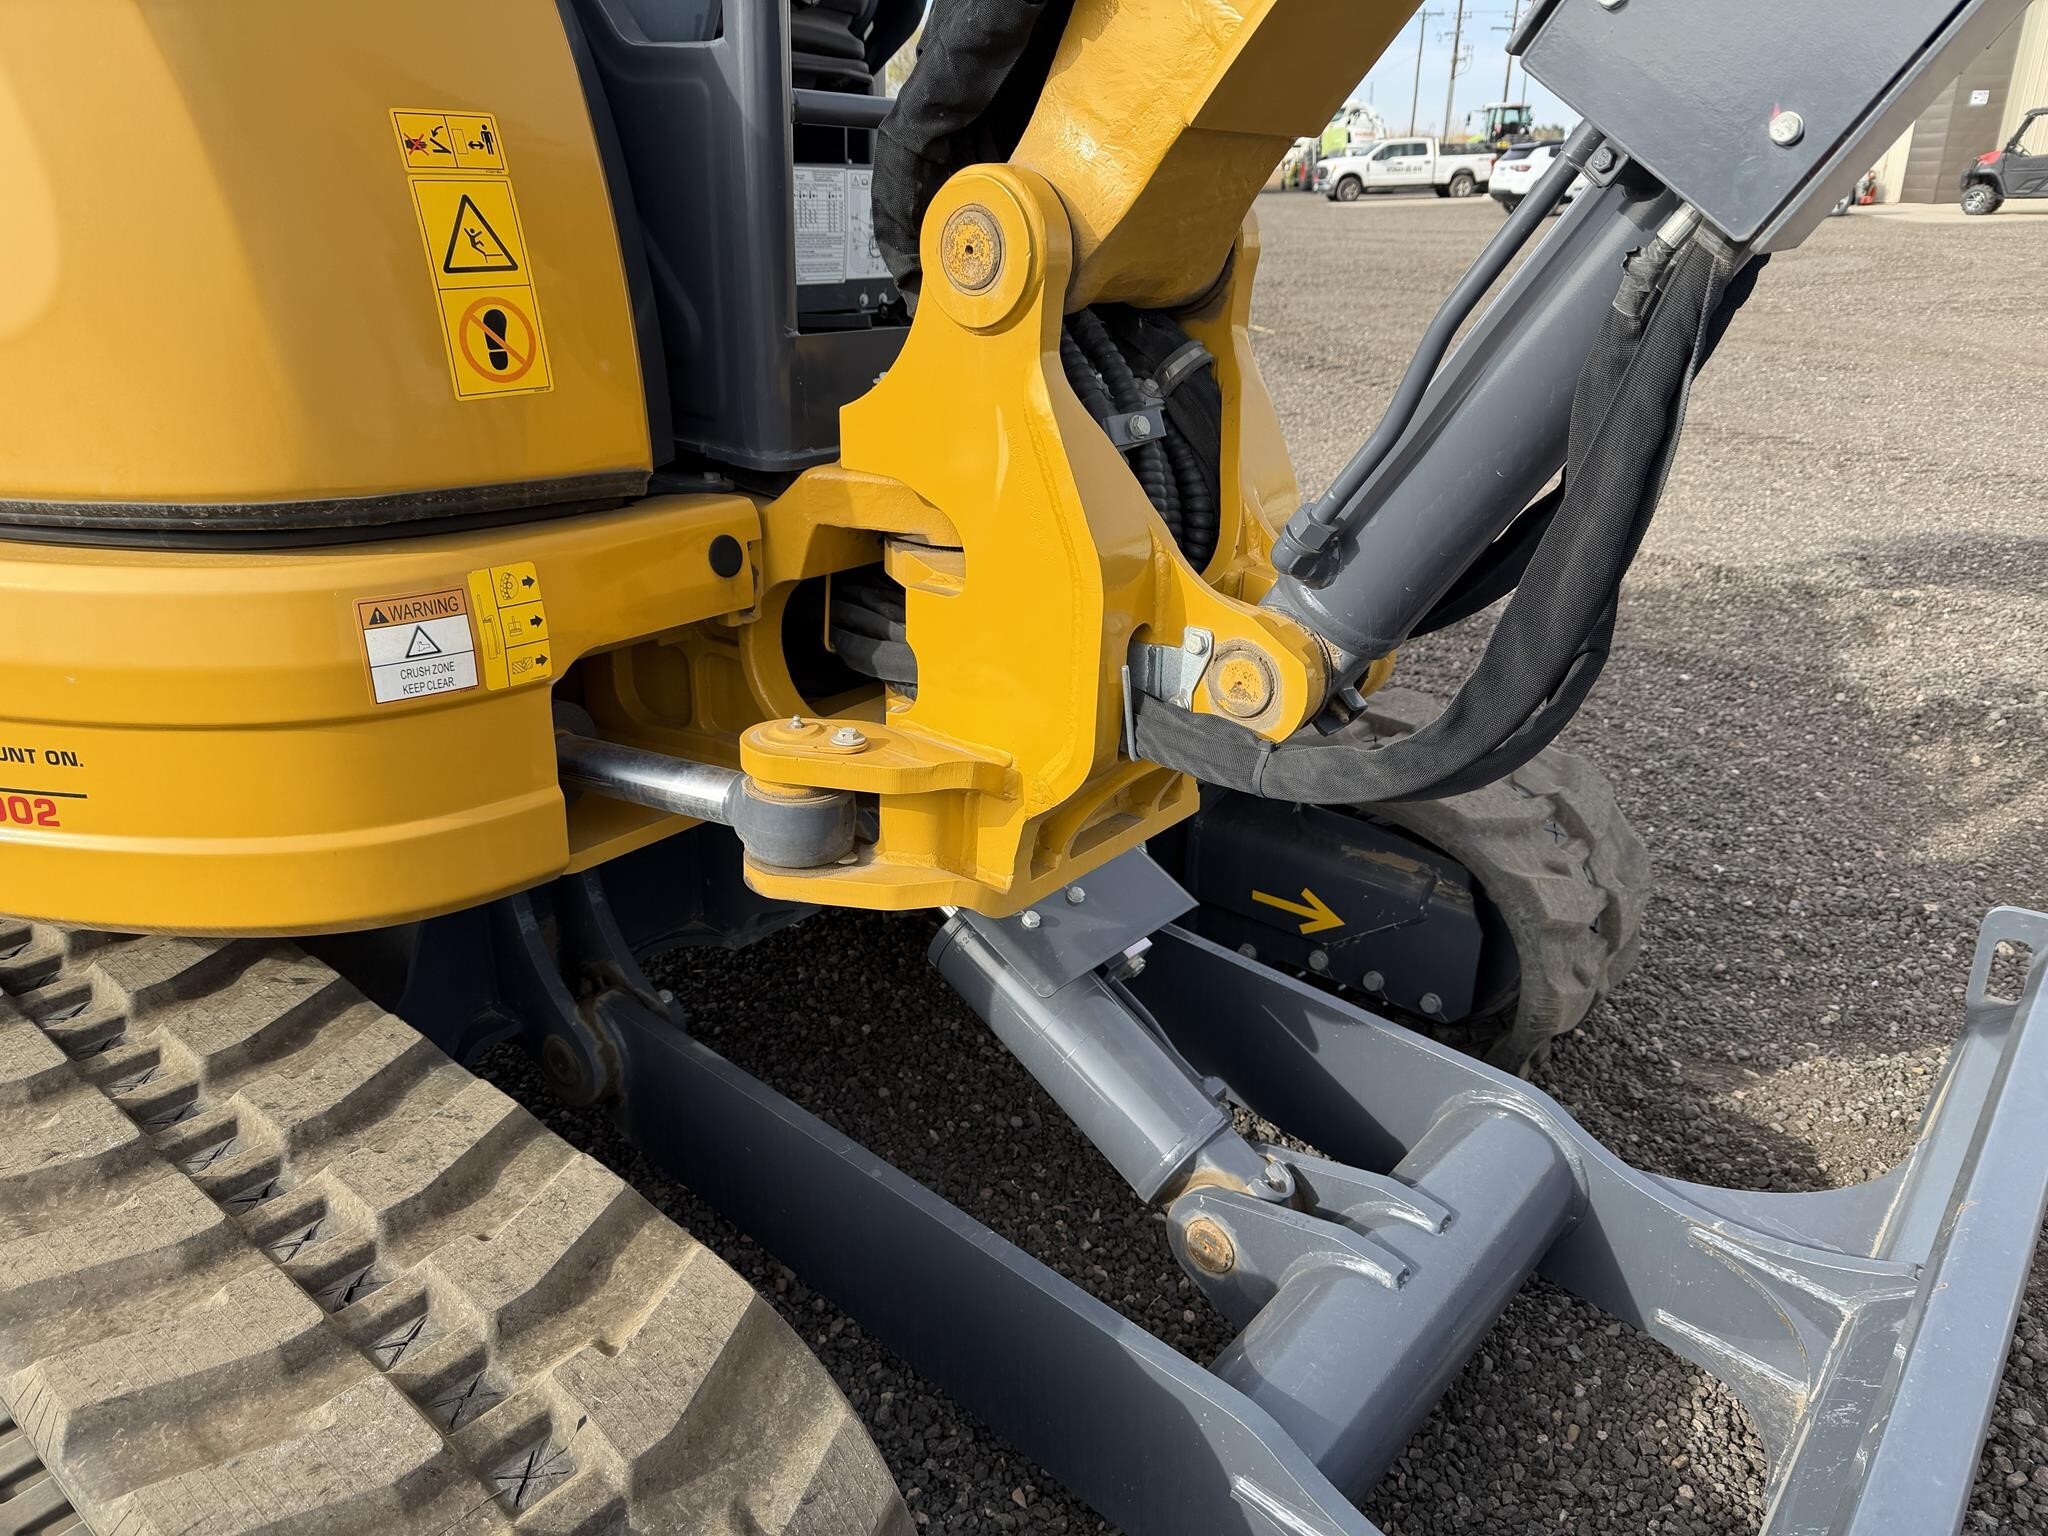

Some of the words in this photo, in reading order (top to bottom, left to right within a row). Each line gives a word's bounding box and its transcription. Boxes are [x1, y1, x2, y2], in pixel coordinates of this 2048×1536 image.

[388, 596, 459, 622] WARNING
[400, 663, 431, 680] CRUSH
[432, 661, 455, 675] ZONE
[402, 681, 427, 695] KEEP
[428, 677, 457, 692] CLEAR.
[45, 749, 84, 767] ON.
[0, 795, 60, 827] 02
